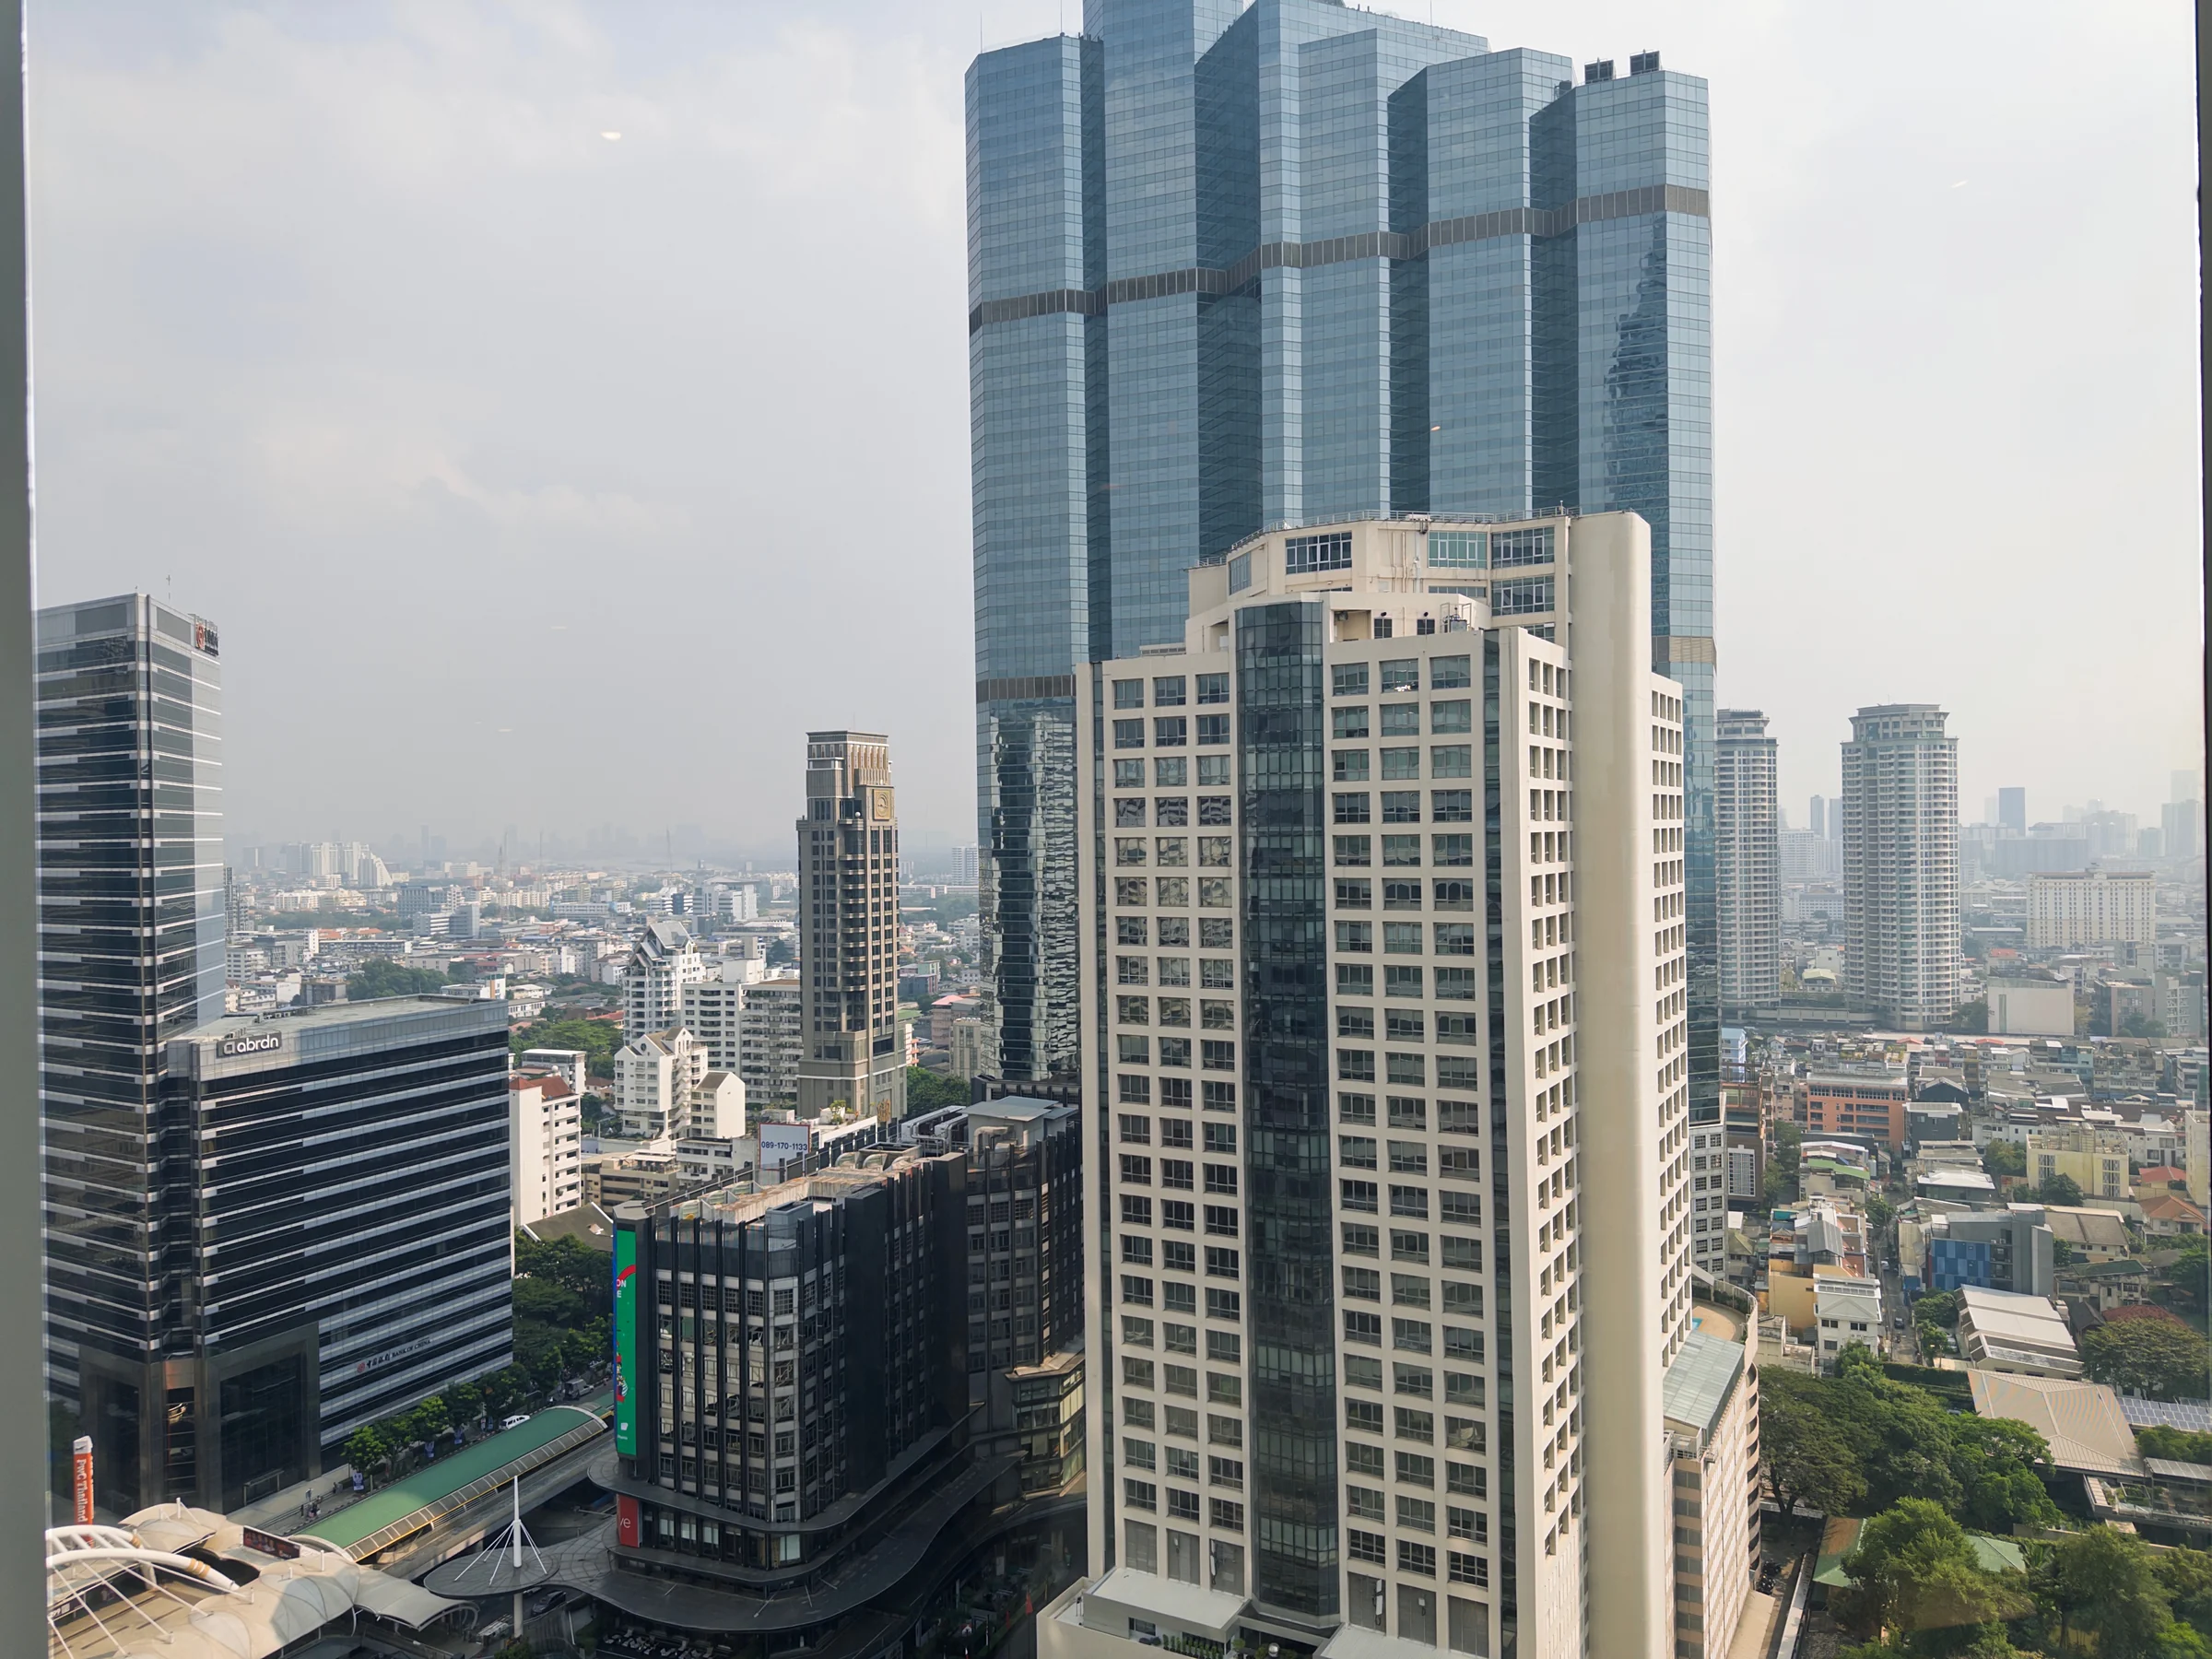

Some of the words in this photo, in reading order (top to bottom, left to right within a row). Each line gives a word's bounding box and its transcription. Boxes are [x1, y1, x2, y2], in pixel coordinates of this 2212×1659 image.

[237, 1034, 279, 1053] abrdn
[760, 1141, 808, 1151] 089-170-1133
[76, 1481, 88, 1523] Thailand
